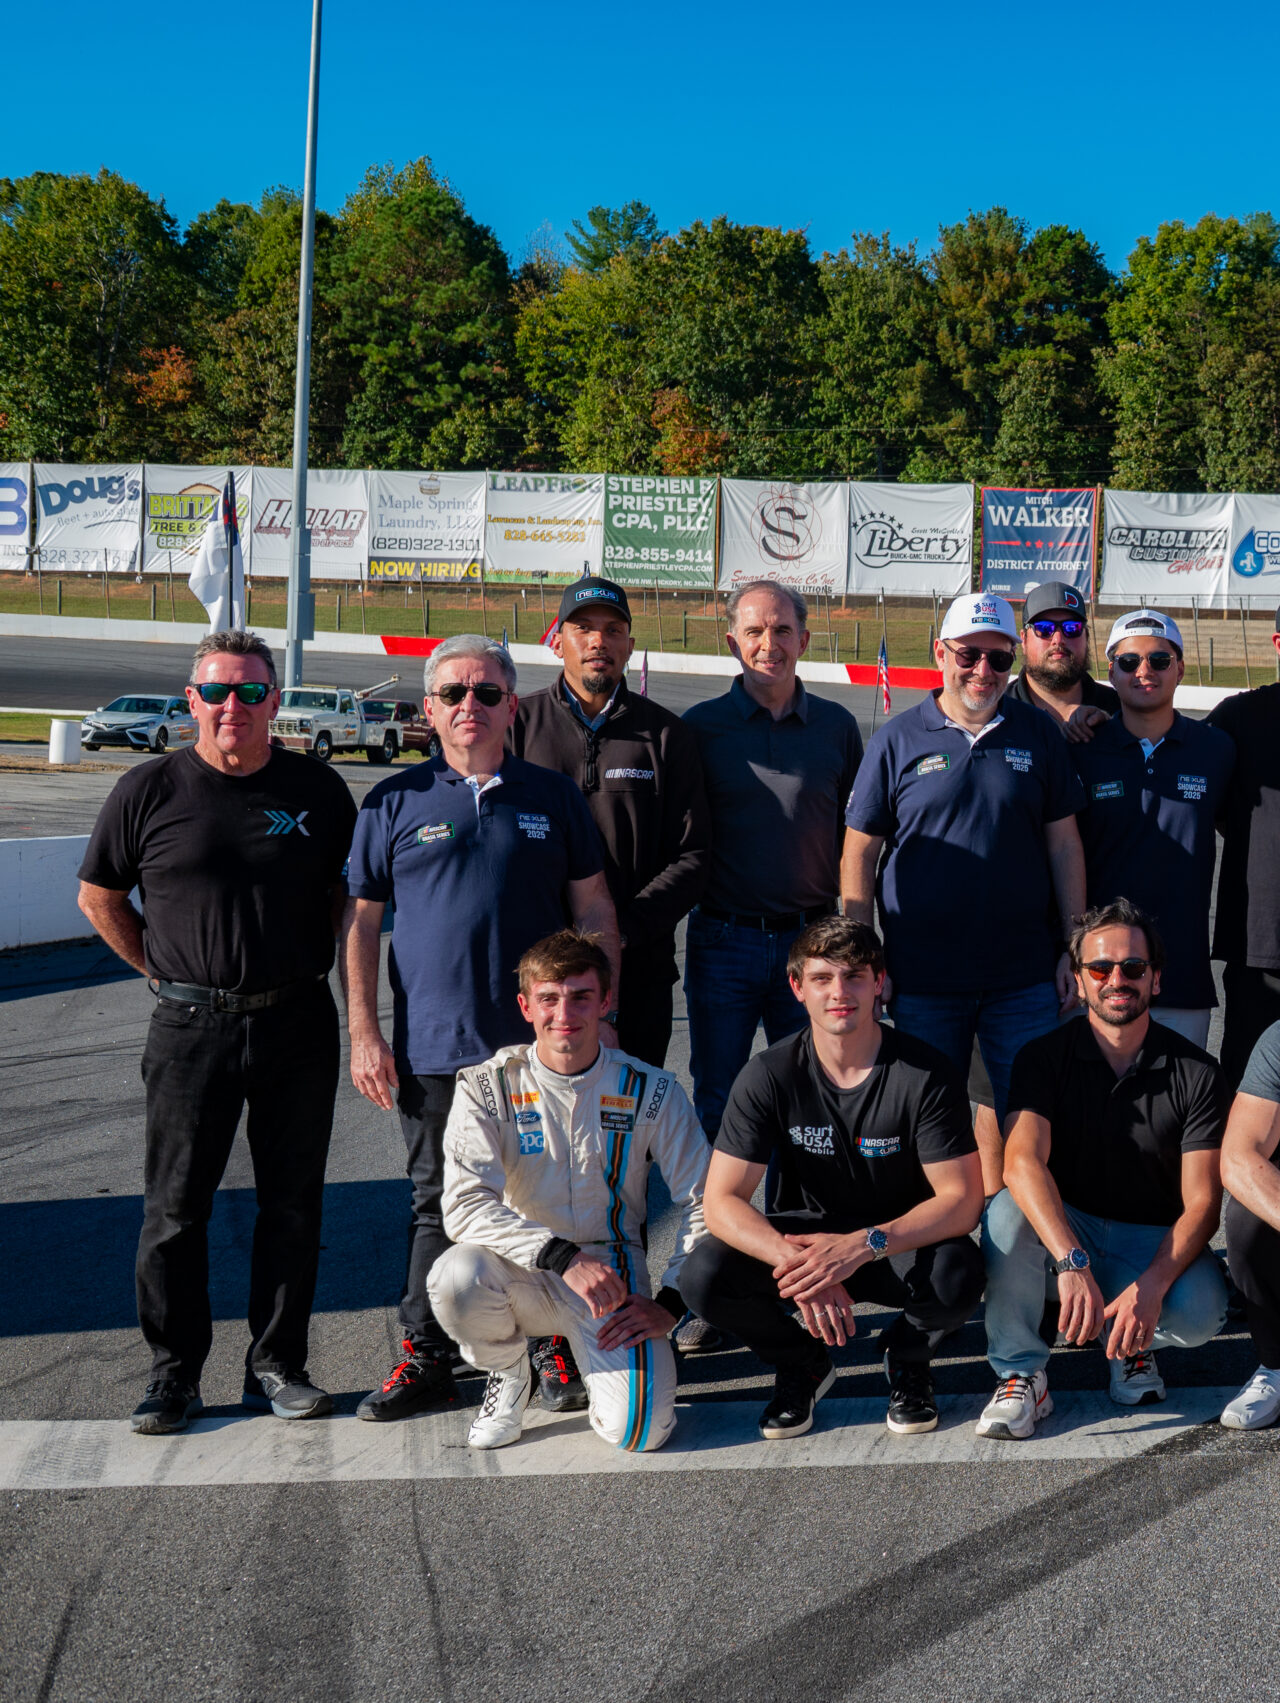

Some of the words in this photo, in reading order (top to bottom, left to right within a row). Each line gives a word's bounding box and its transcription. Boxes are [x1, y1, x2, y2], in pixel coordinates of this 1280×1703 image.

[608, 477, 695, 495] STEPHEN
[37, 472, 141, 517] Doug's
[1025, 496, 1053, 505] MITCH
[377, 495, 423, 513] Maple
[428, 496, 478, 516] Springs
[608, 495, 713, 517] PRIESTLEY,
[57, 514, 80, 528] fleet
[257, 499, 368, 531] HLLAR
[378, 514, 440, 531] Laundry,
[447, 515, 476, 530] LLC
[987, 505, 1091, 528] WALKER
[153, 521, 183, 532] TREE
[188, 524, 196, 532] &
[612, 513, 658, 534] CPA,
[663, 515, 710, 532] PLLC
[372, 536, 481, 551] (828)322-1301
[863, 527, 971, 562] Liberty
[1109, 528, 1228, 550] CAROLINA
[39, 549, 137, 565] 828.327.640
[604, 545, 713, 563] 828-855-9414
[890, 552, 922, 561] BUICK-GMC
[923, 553, 946, 561] TRUCKS
[370, 561, 416, 576] NOW
[420, 562, 482, 578] HIRING
[604, 561, 713, 573] STEPHENPRIESTLEYCPA.COM
[986, 559, 1033, 571] DISTRICT
[1034, 560, 1090, 572] ATTORNEY
[731, 569, 765, 583] Smart
[768, 571, 803, 585] Electric
[806, 573, 818, 586] Co
[820, 573, 836, 586] Inc
[981, 606, 997, 614] USA
[616, 768, 655, 780] NASCAR
[1177, 783, 1207, 793] SHOWCASE
[1183, 791, 1201, 800] 2025
[518, 821, 551, 832] SHOWCASE
[527, 829, 546, 840] 2025
[477, 1072, 499, 1118] sparco
[646, 1077, 668, 1120] sparco
[516, 1113, 537, 1123] Ford
[803, 1136, 834, 1149] USA
[864, 1136, 900, 1148] NASCAR
[804, 1146, 835, 1156] mobile
